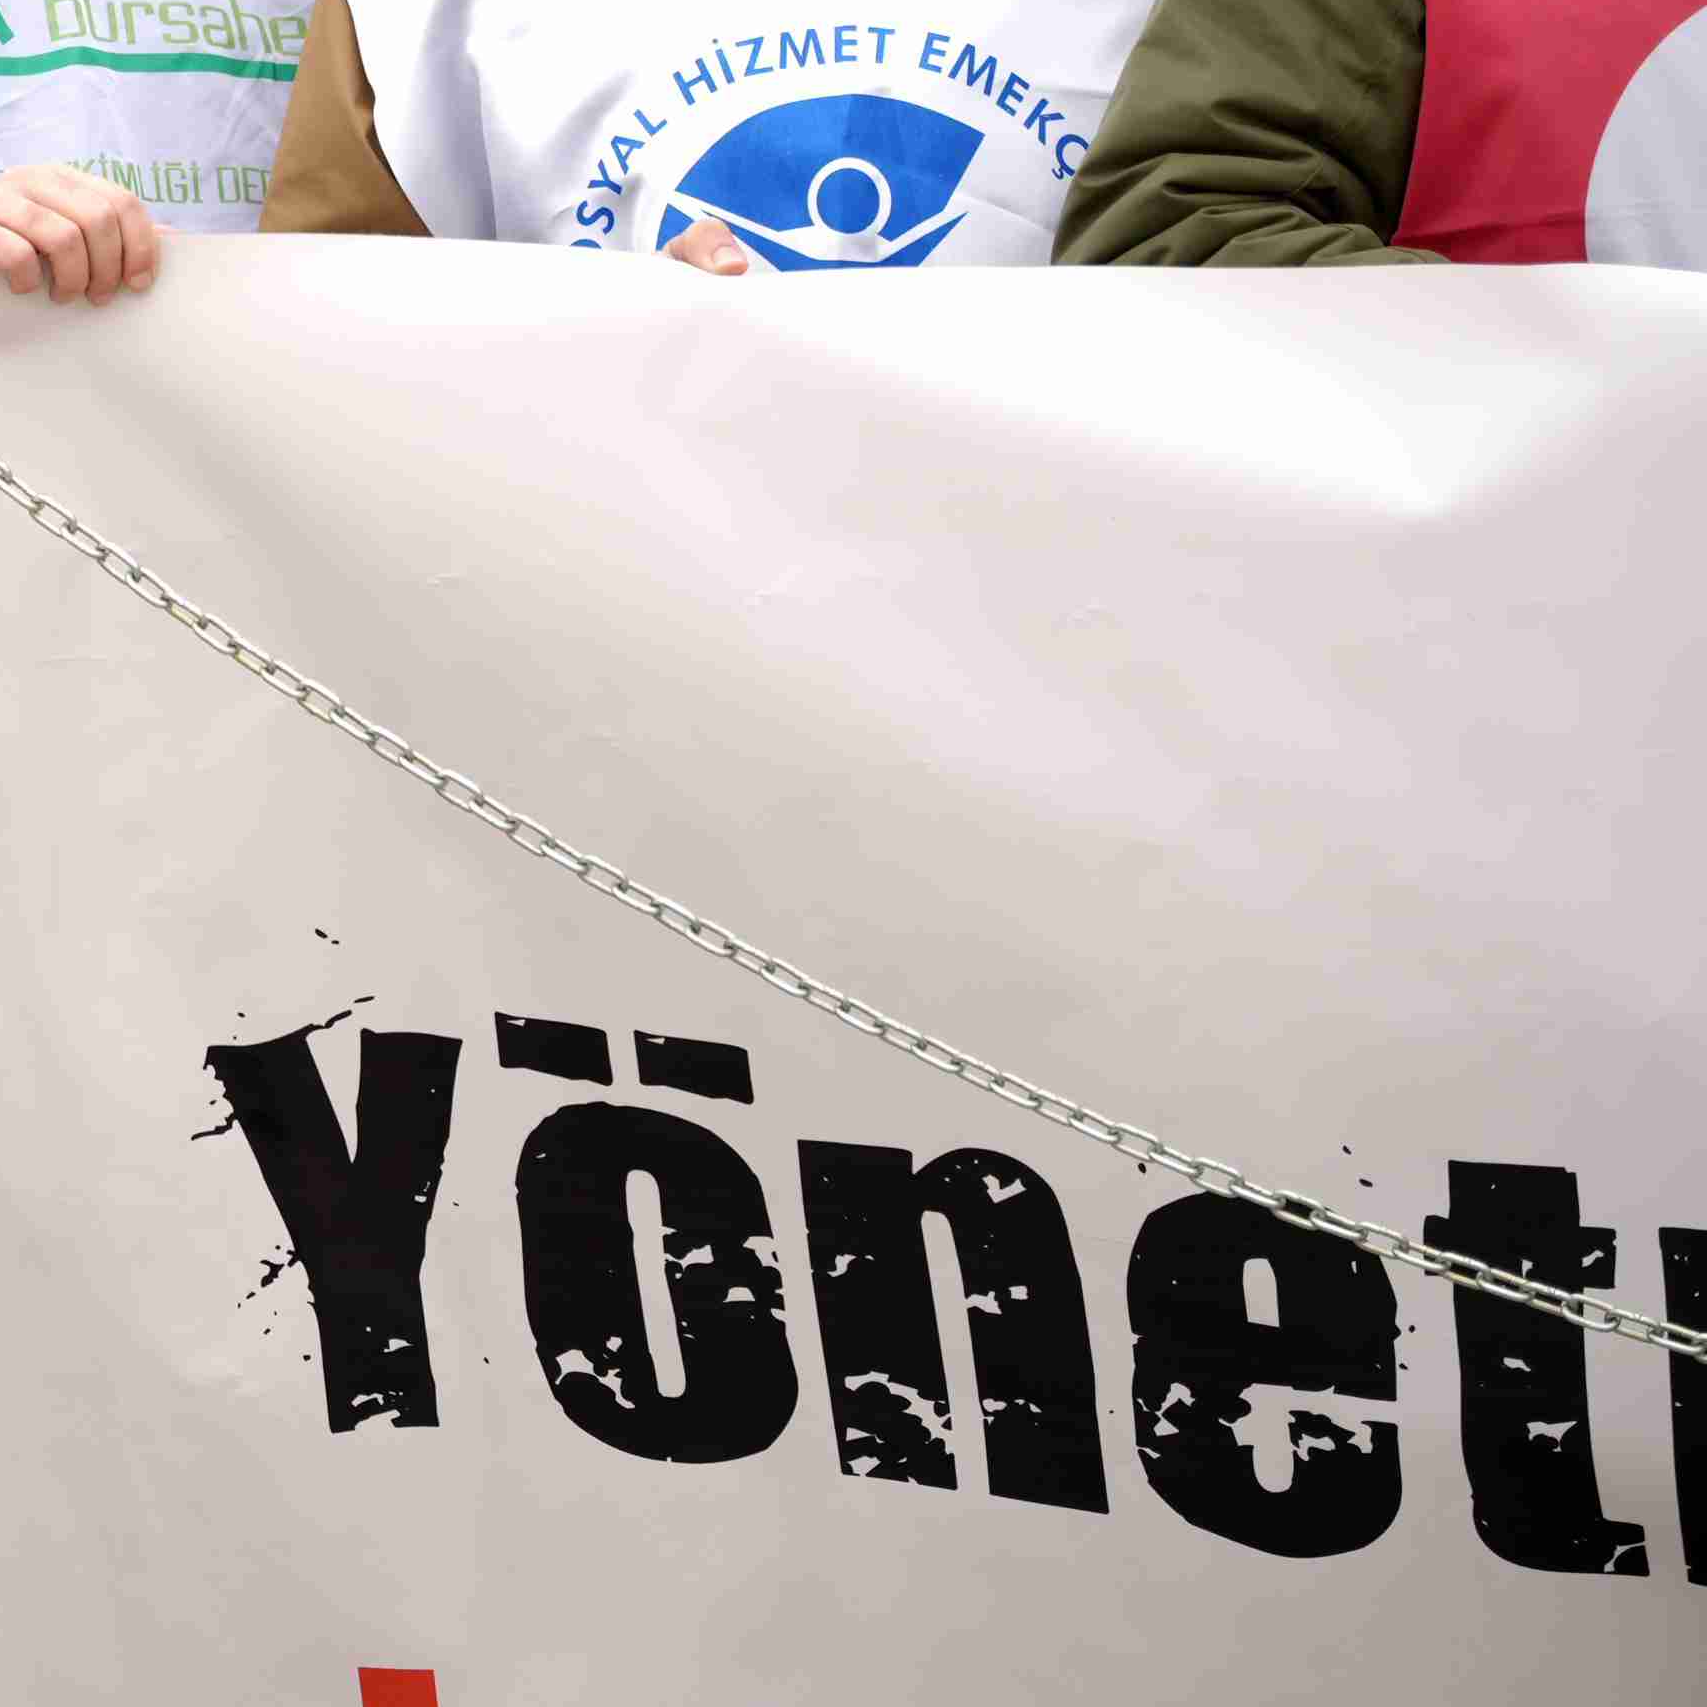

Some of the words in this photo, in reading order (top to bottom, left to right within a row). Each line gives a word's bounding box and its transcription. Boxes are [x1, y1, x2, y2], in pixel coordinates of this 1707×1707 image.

[569, 108, 668, 250] SYAL
[672, 24, 895, 107] HİZMET
[918, 31, 1089, 181] EMEKÇ
[197, 1011, 1707, 1586] Yönet
